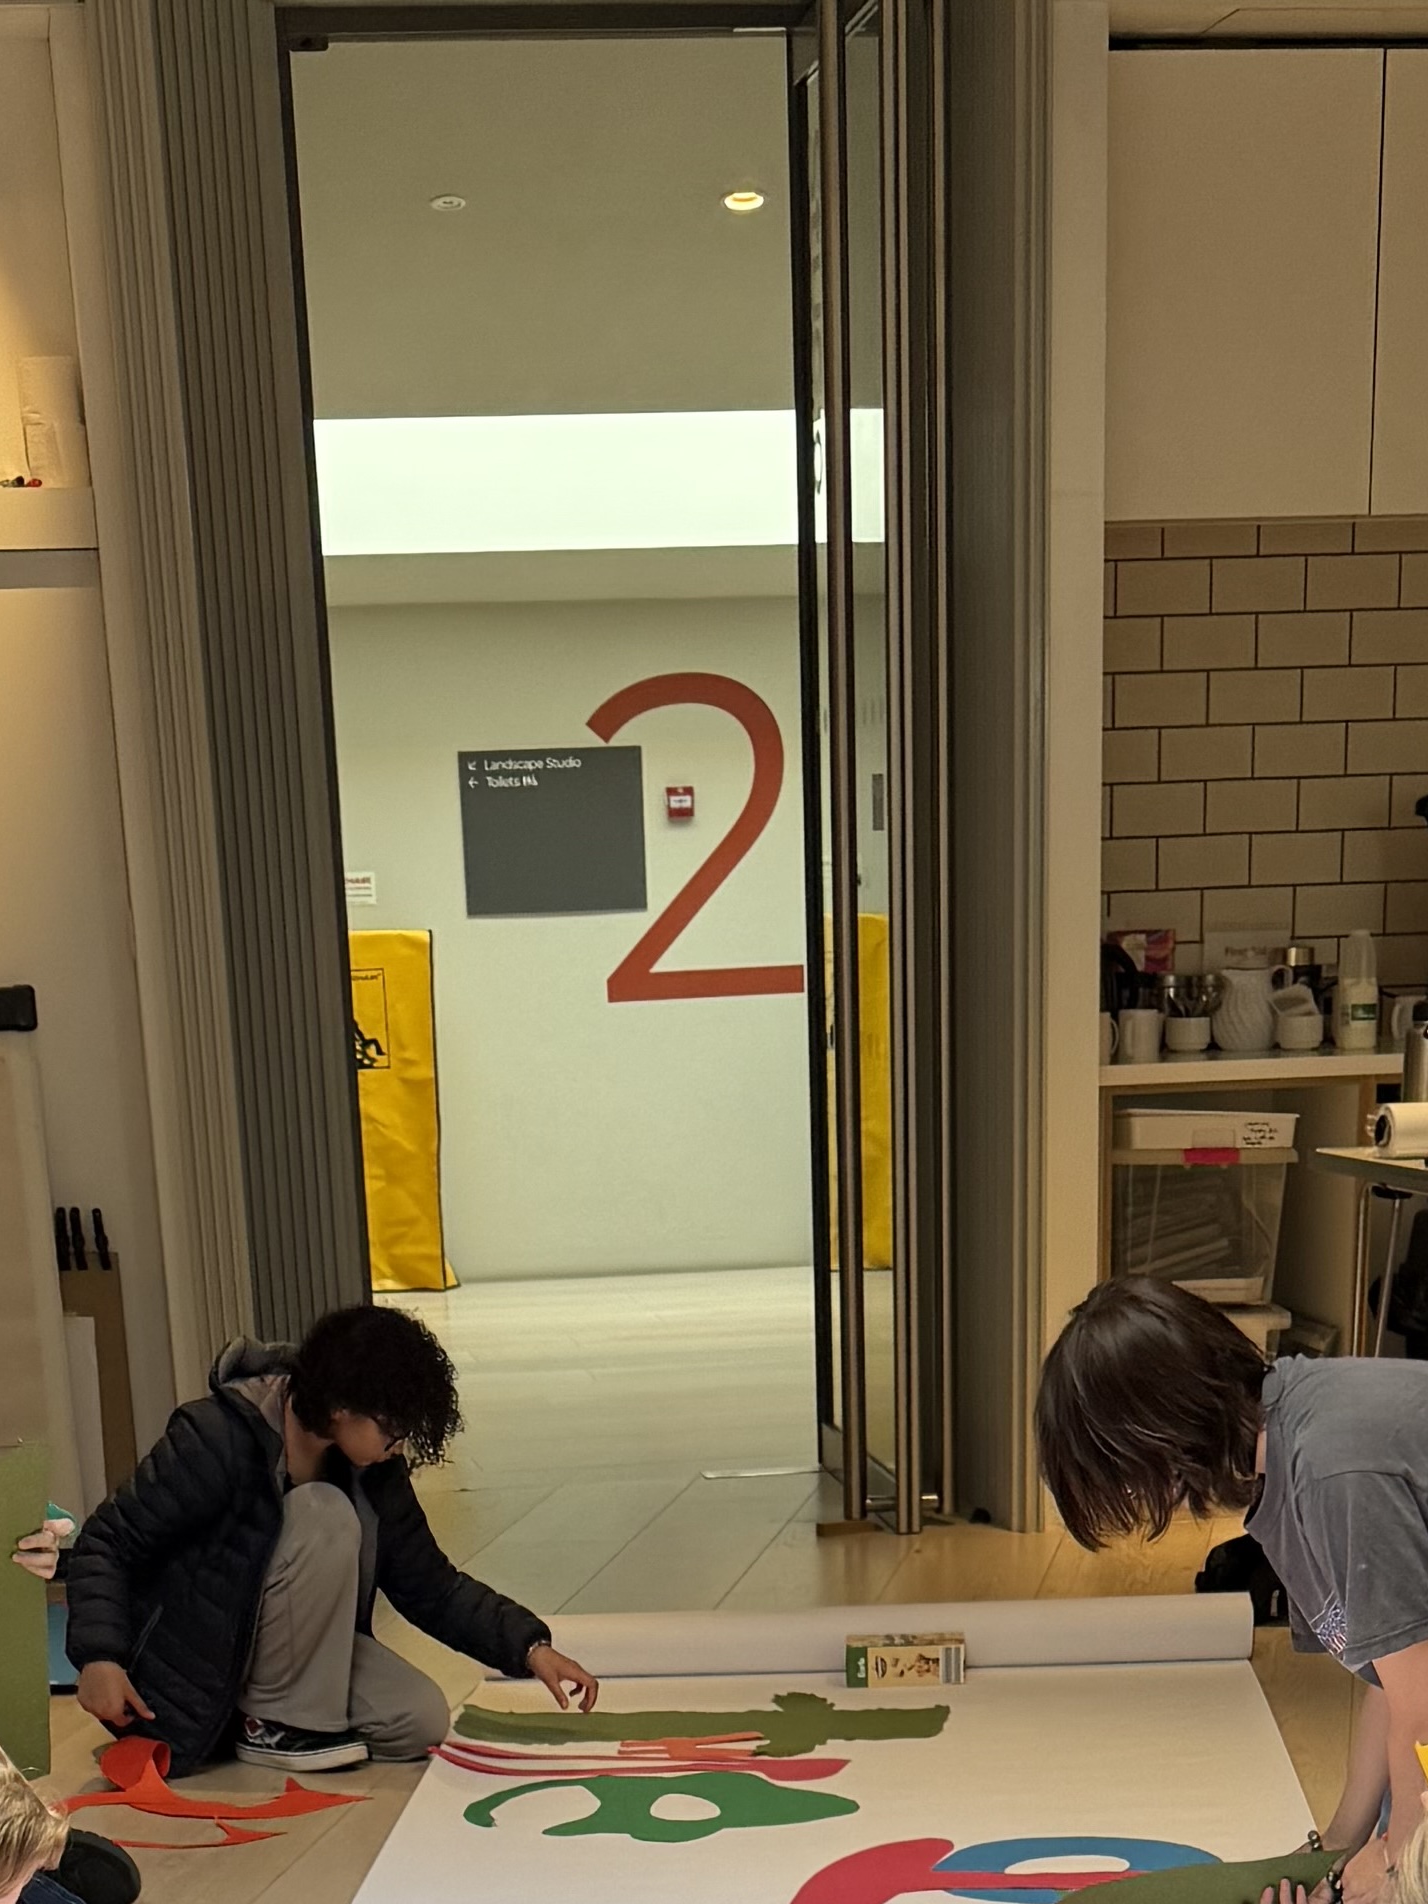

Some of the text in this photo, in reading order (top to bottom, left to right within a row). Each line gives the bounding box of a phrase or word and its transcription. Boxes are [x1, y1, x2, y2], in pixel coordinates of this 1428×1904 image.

[483, 756, 582, 771] Landscape Studio
[486, 775, 521, 788] Toilets
[585, 671, 805, 1003] 2
